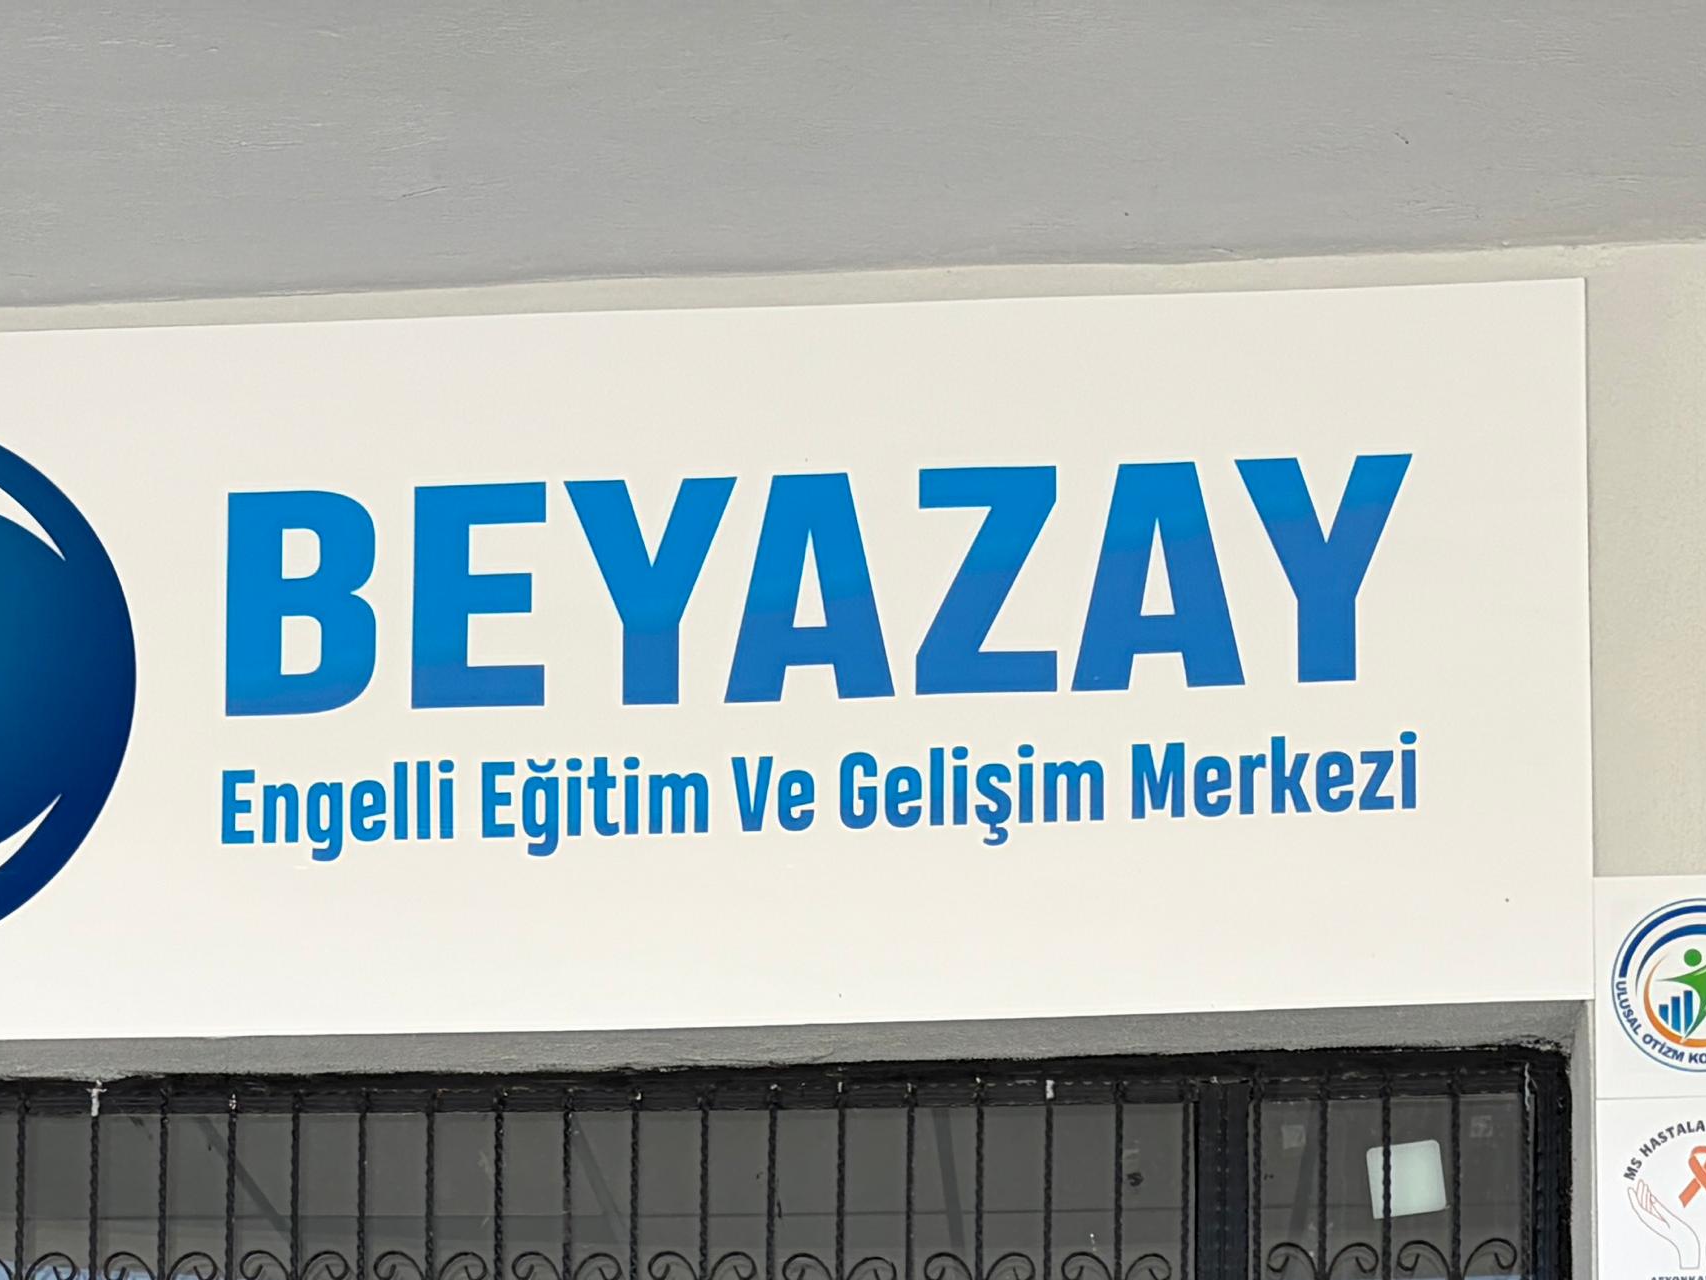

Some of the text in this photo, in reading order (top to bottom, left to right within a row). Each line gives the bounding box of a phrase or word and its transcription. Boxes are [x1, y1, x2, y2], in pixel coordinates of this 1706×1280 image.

[224, 453, 1414, 718] BEYAZAY
[220, 730, 1419, 864] Engelli Eğitim Ve Gelişim Merkezi
[1615, 980, 1642, 1035] ULUSAL
[1642, 1033, 1685, 1063] OTİZM
[1623, 1157, 1643, 1181] MS
